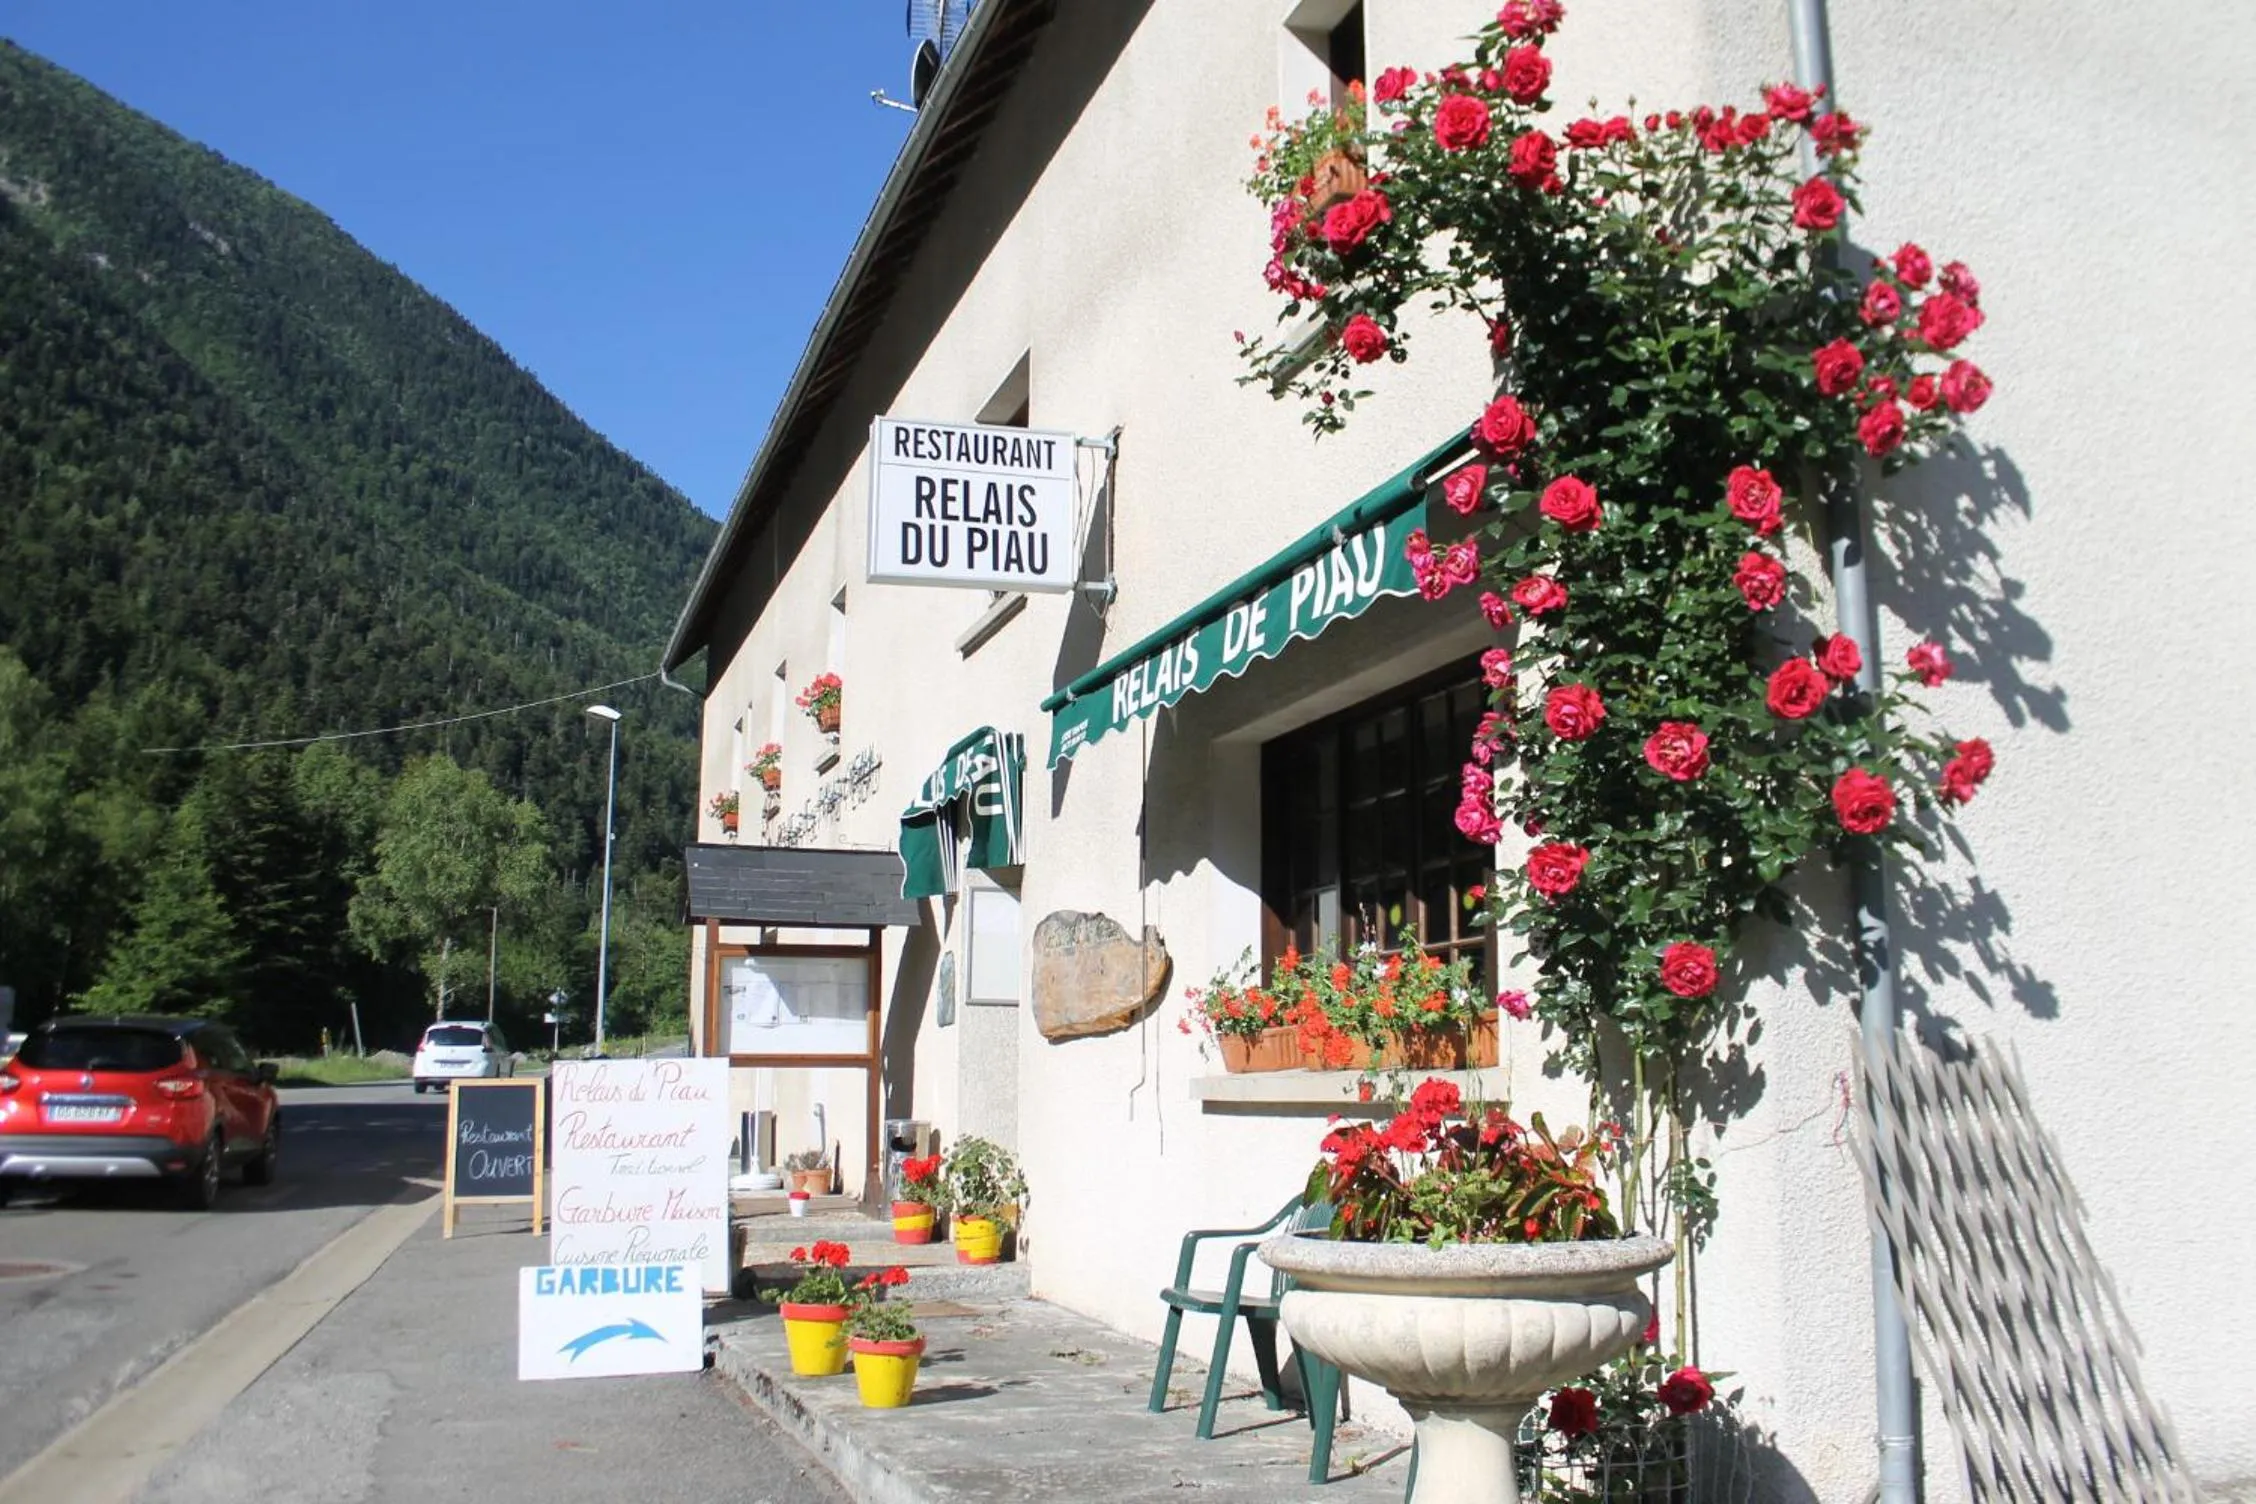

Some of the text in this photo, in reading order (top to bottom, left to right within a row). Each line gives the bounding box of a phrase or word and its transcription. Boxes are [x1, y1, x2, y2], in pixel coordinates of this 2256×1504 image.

[894, 426, 1056, 470] RESTAURANT
[915, 476, 1037, 528] RELAIS
[901, 521, 1048, 575] DU PIAU
[1112, 522, 1386, 723] RELAIS DE PIAU
[655, 1062, 710, 1101] Piau
[459, 1119, 532, 1144] Restaurant
[558, 1110, 696, 1150] Restaurant
[558, 1185, 722, 1224] Garbure Maison
[536, 1266, 684, 1295] GARBURE
